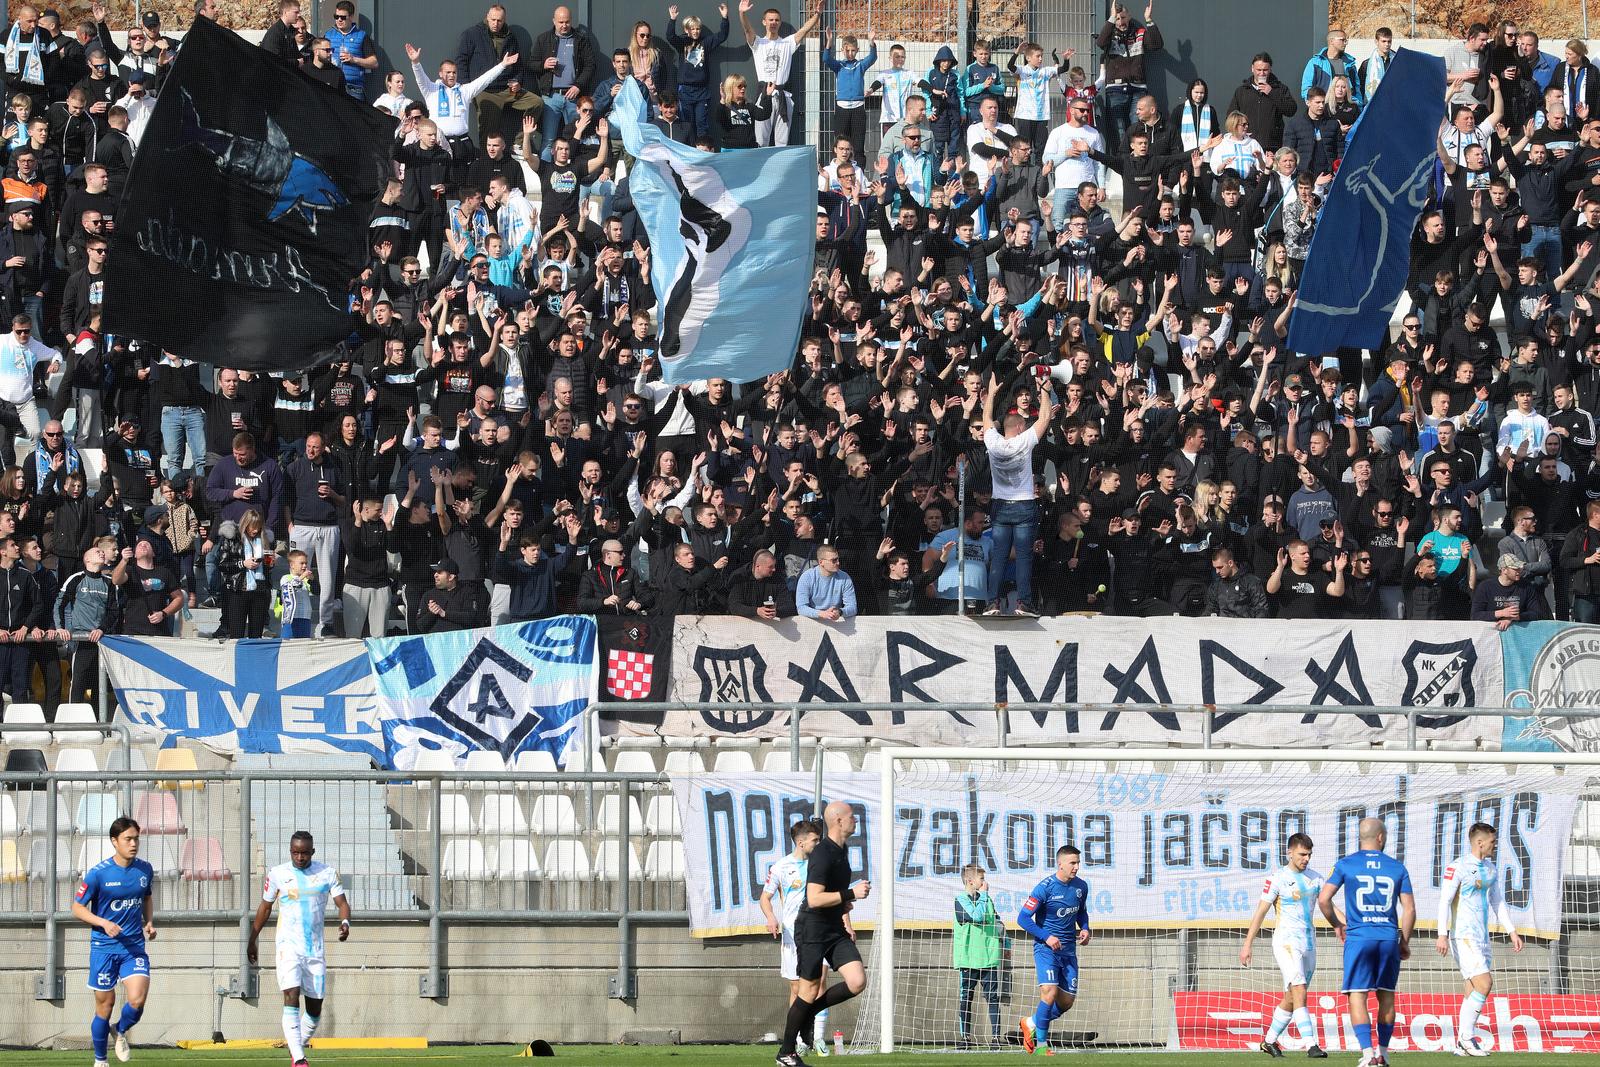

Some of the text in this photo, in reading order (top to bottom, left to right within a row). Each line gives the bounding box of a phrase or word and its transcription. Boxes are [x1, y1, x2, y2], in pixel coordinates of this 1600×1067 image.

[235, 477, 259, 487] PUMA
[785, 629, 1384, 734] ARMADA
[1412, 655, 1468, 707] RIJEKA
[1421, 659, 1437, 672] NK
[123, 689, 382, 733] RIVER
[1095, 773, 1168, 806] 1987
[896, 774, 1115, 880] zakona
[1163, 877, 1250, 921] rijeka
[1355, 875, 1394, 912] 23
[97, 972, 111, 986] 25
[1046, 969, 1055, 981] 11
[1279, 995, 1543, 1052] aicash
